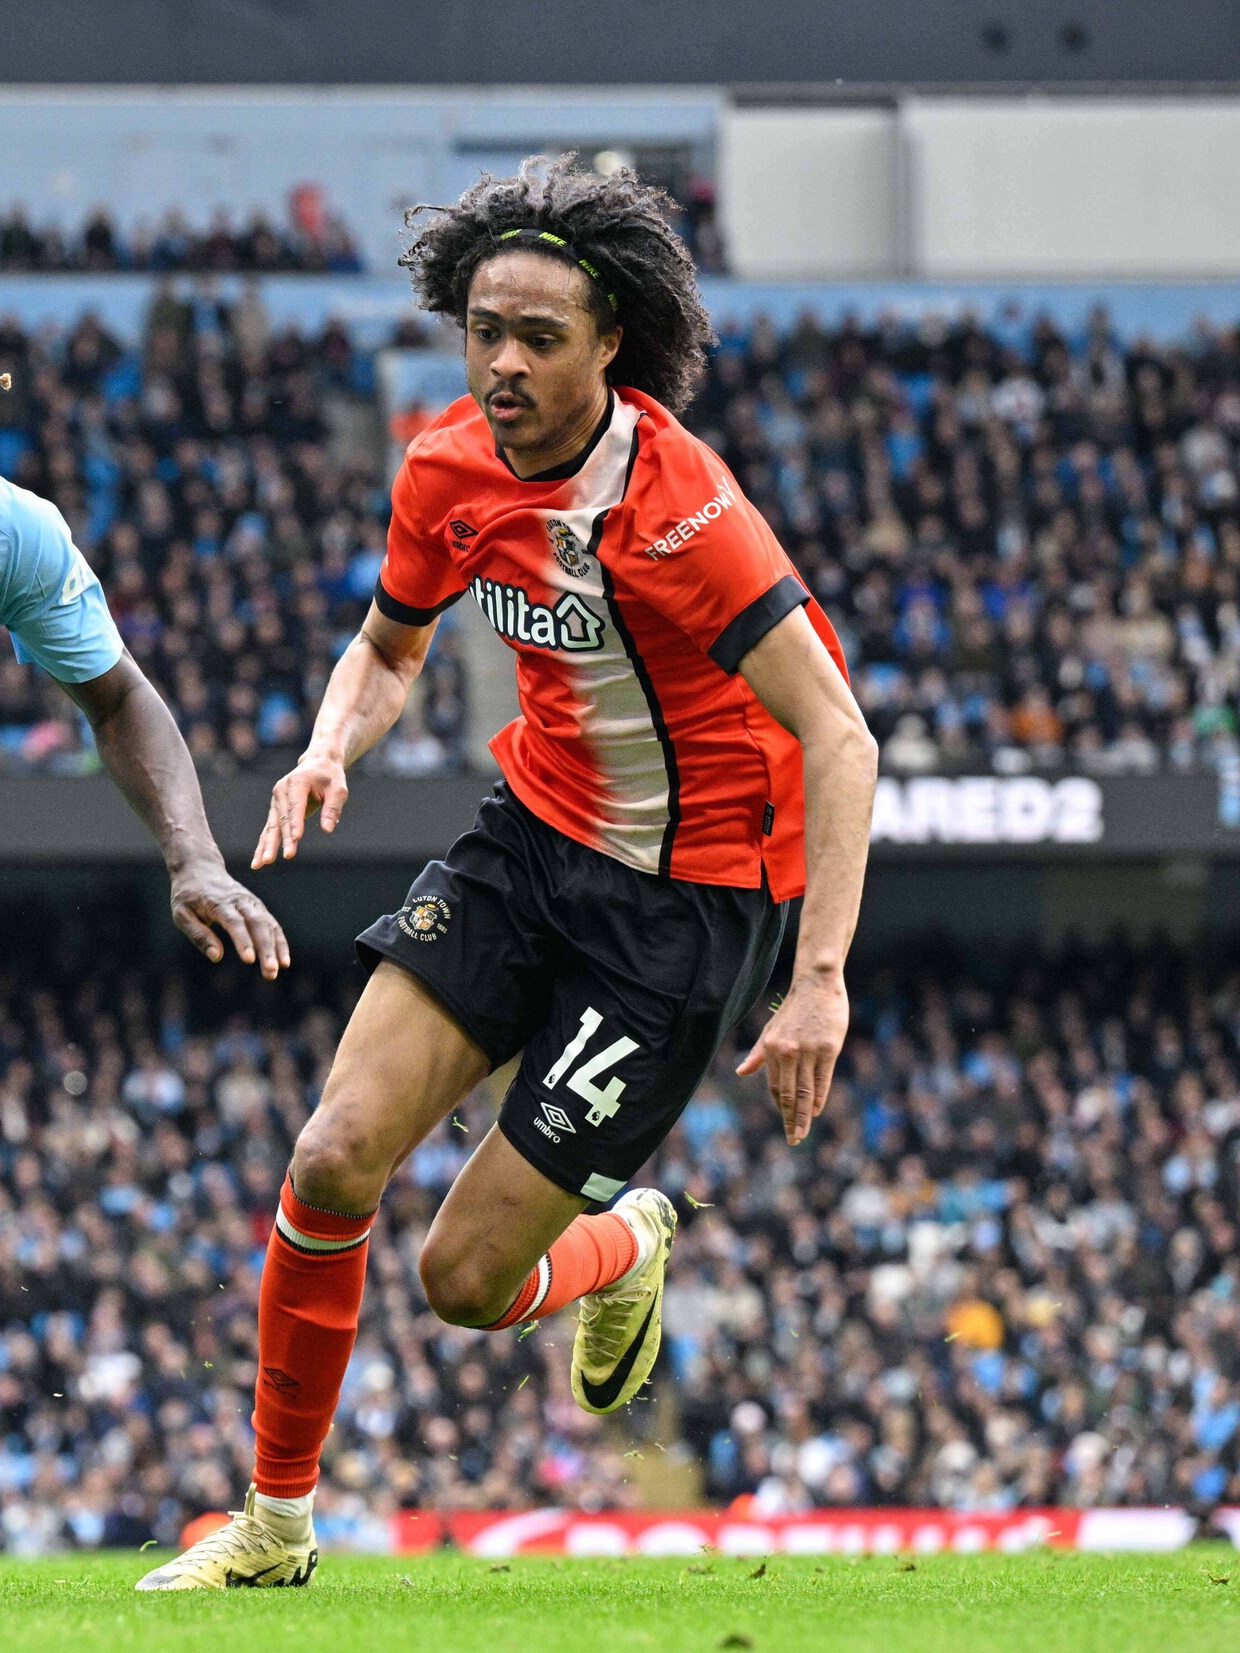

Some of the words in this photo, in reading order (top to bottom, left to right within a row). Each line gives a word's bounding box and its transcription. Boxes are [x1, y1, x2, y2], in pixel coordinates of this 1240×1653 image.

[538, 231, 567, 247] NIKE
[578, 259, 600, 279] NIKE
[469, 577, 557, 647] tilita
[412, 895, 438, 903] LUTON
[437, 899, 451, 919] TOWN
[398, 916, 418, 939] FOOTBALL
[420, 932, 437, 942] CLUB
[542, 1006, 641, 1127] 14
[533, 1116, 561, 1143] umbro
